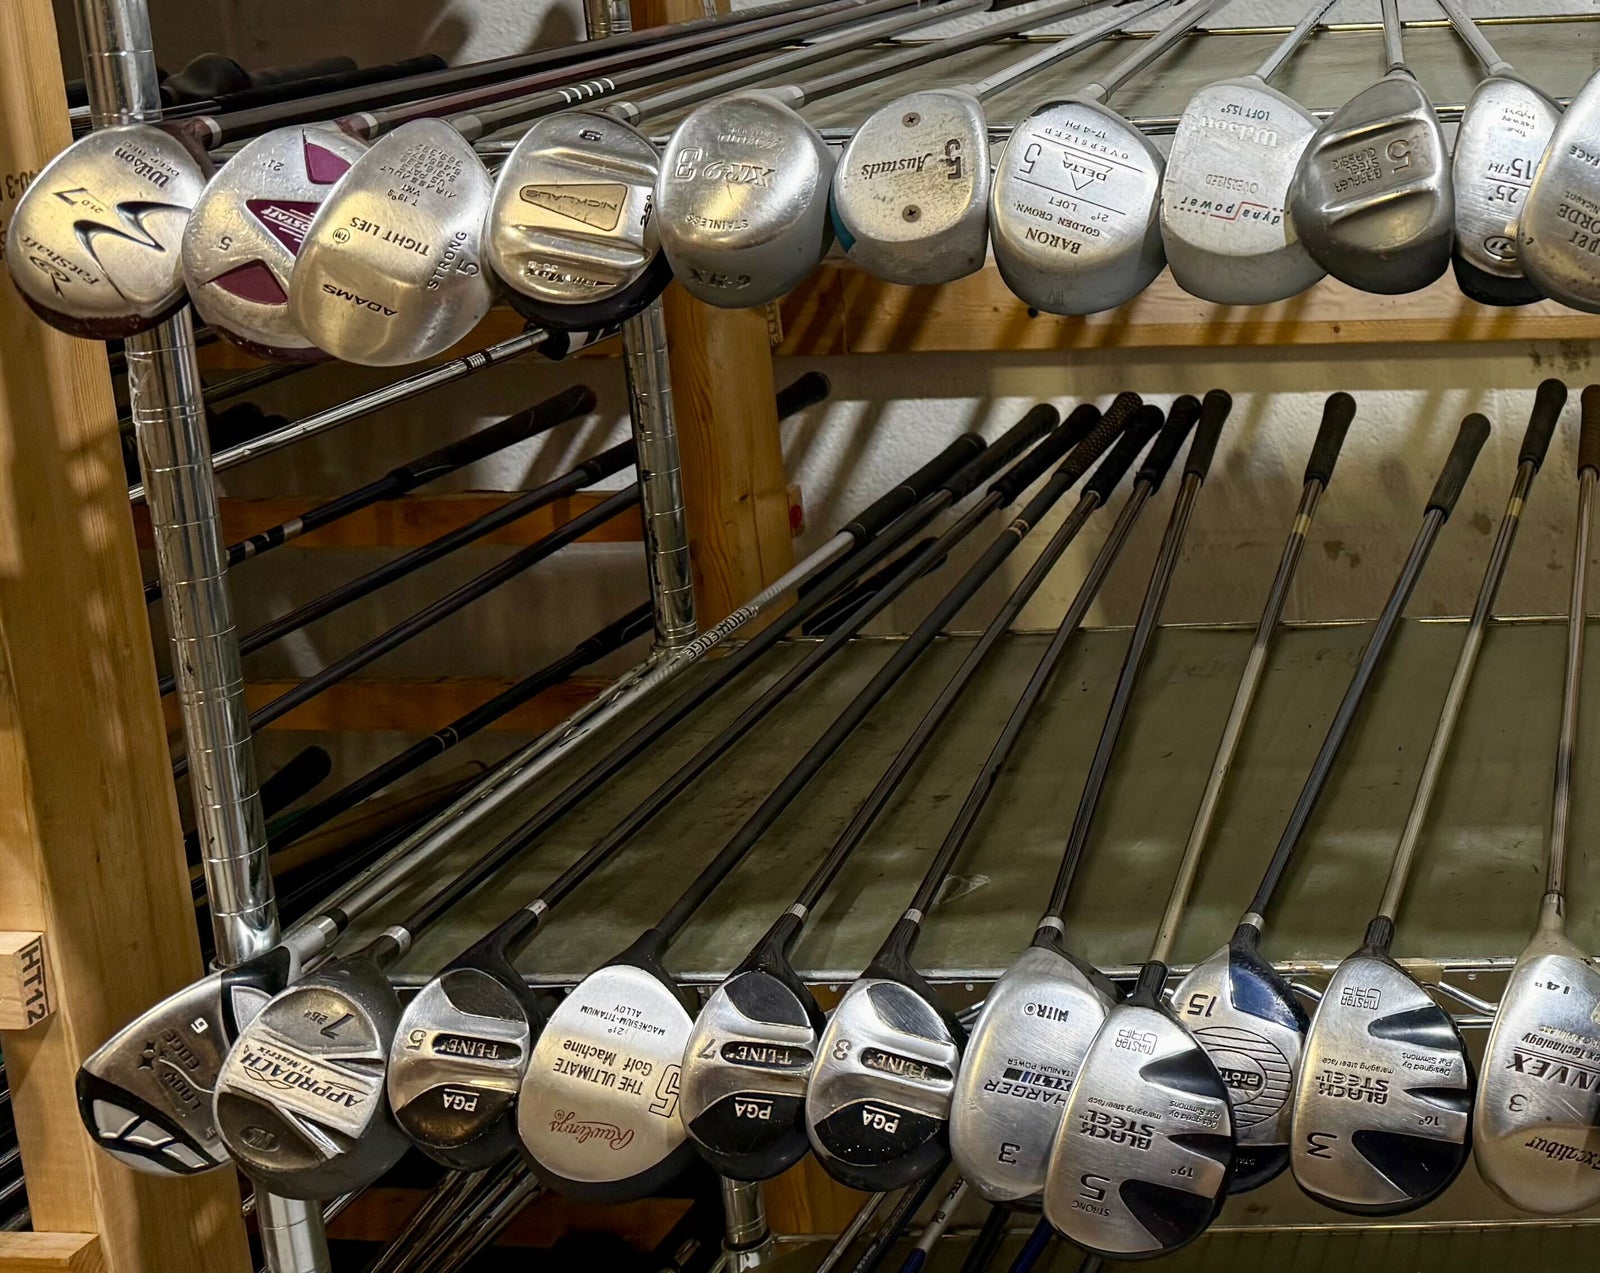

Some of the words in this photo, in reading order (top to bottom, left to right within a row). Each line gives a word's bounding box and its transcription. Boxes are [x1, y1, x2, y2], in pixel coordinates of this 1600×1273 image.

[1244, 109, 1271, 121] LOFT
[1044, 127, 1129, 160] OVERSIZED
[675, 148, 702, 180] 3
[944, 139, 963, 181] 5
[1020, 142, 1042, 175] 5
[1386, 138, 1414, 174] 5
[113, 147, 172, 190] Wilson
[1063, 159, 1108, 182] DELTA
[52, 186, 91, 208] 7
[525, 188, 618, 221] NICKLAUS
[1048, 196, 1079, 212] LOFT
[1181, 195, 1235, 217] power
[349, 215, 381, 237] LIES
[1057, 215, 1101, 237] GOLDEN
[1242, 204, 1281, 226] dyna
[382, 228, 431, 258] TIGHT
[1025, 226, 1083, 255] BARON
[427, 229, 469, 291] STRONG
[457, 258, 480, 278] 5
[323, 283, 399, 317] ADAMS
[614, 1004, 643, 1017] ALLOY
[321, 1012, 349, 1040] 7
[563, 1039, 618, 1063] Machine
[553, 1058, 617, 1088] ULTIMATE
[622, 1055, 653, 1077] Golf
[240, 1052, 365, 1109] APPROACH
[617, 1076, 645, 1096] THE
[443, 1093, 478, 1112] PGA
[1318, 1083, 1388, 1106] BLACK
[1509, 1094, 1528, 1113] 3
[734, 1101, 772, 1120] PGA
[862, 1109, 899, 1133] PGA
[549, 1118, 635, 1151] Rawlings
[1079, 1122, 1153, 1151] BLACK
[1306, 1132, 1338, 1160] 3
[998, 1142, 1021, 1167] 3
[1080, 1173, 1111, 1202] 5
[1072, 1199, 1111, 1218] STRONG
